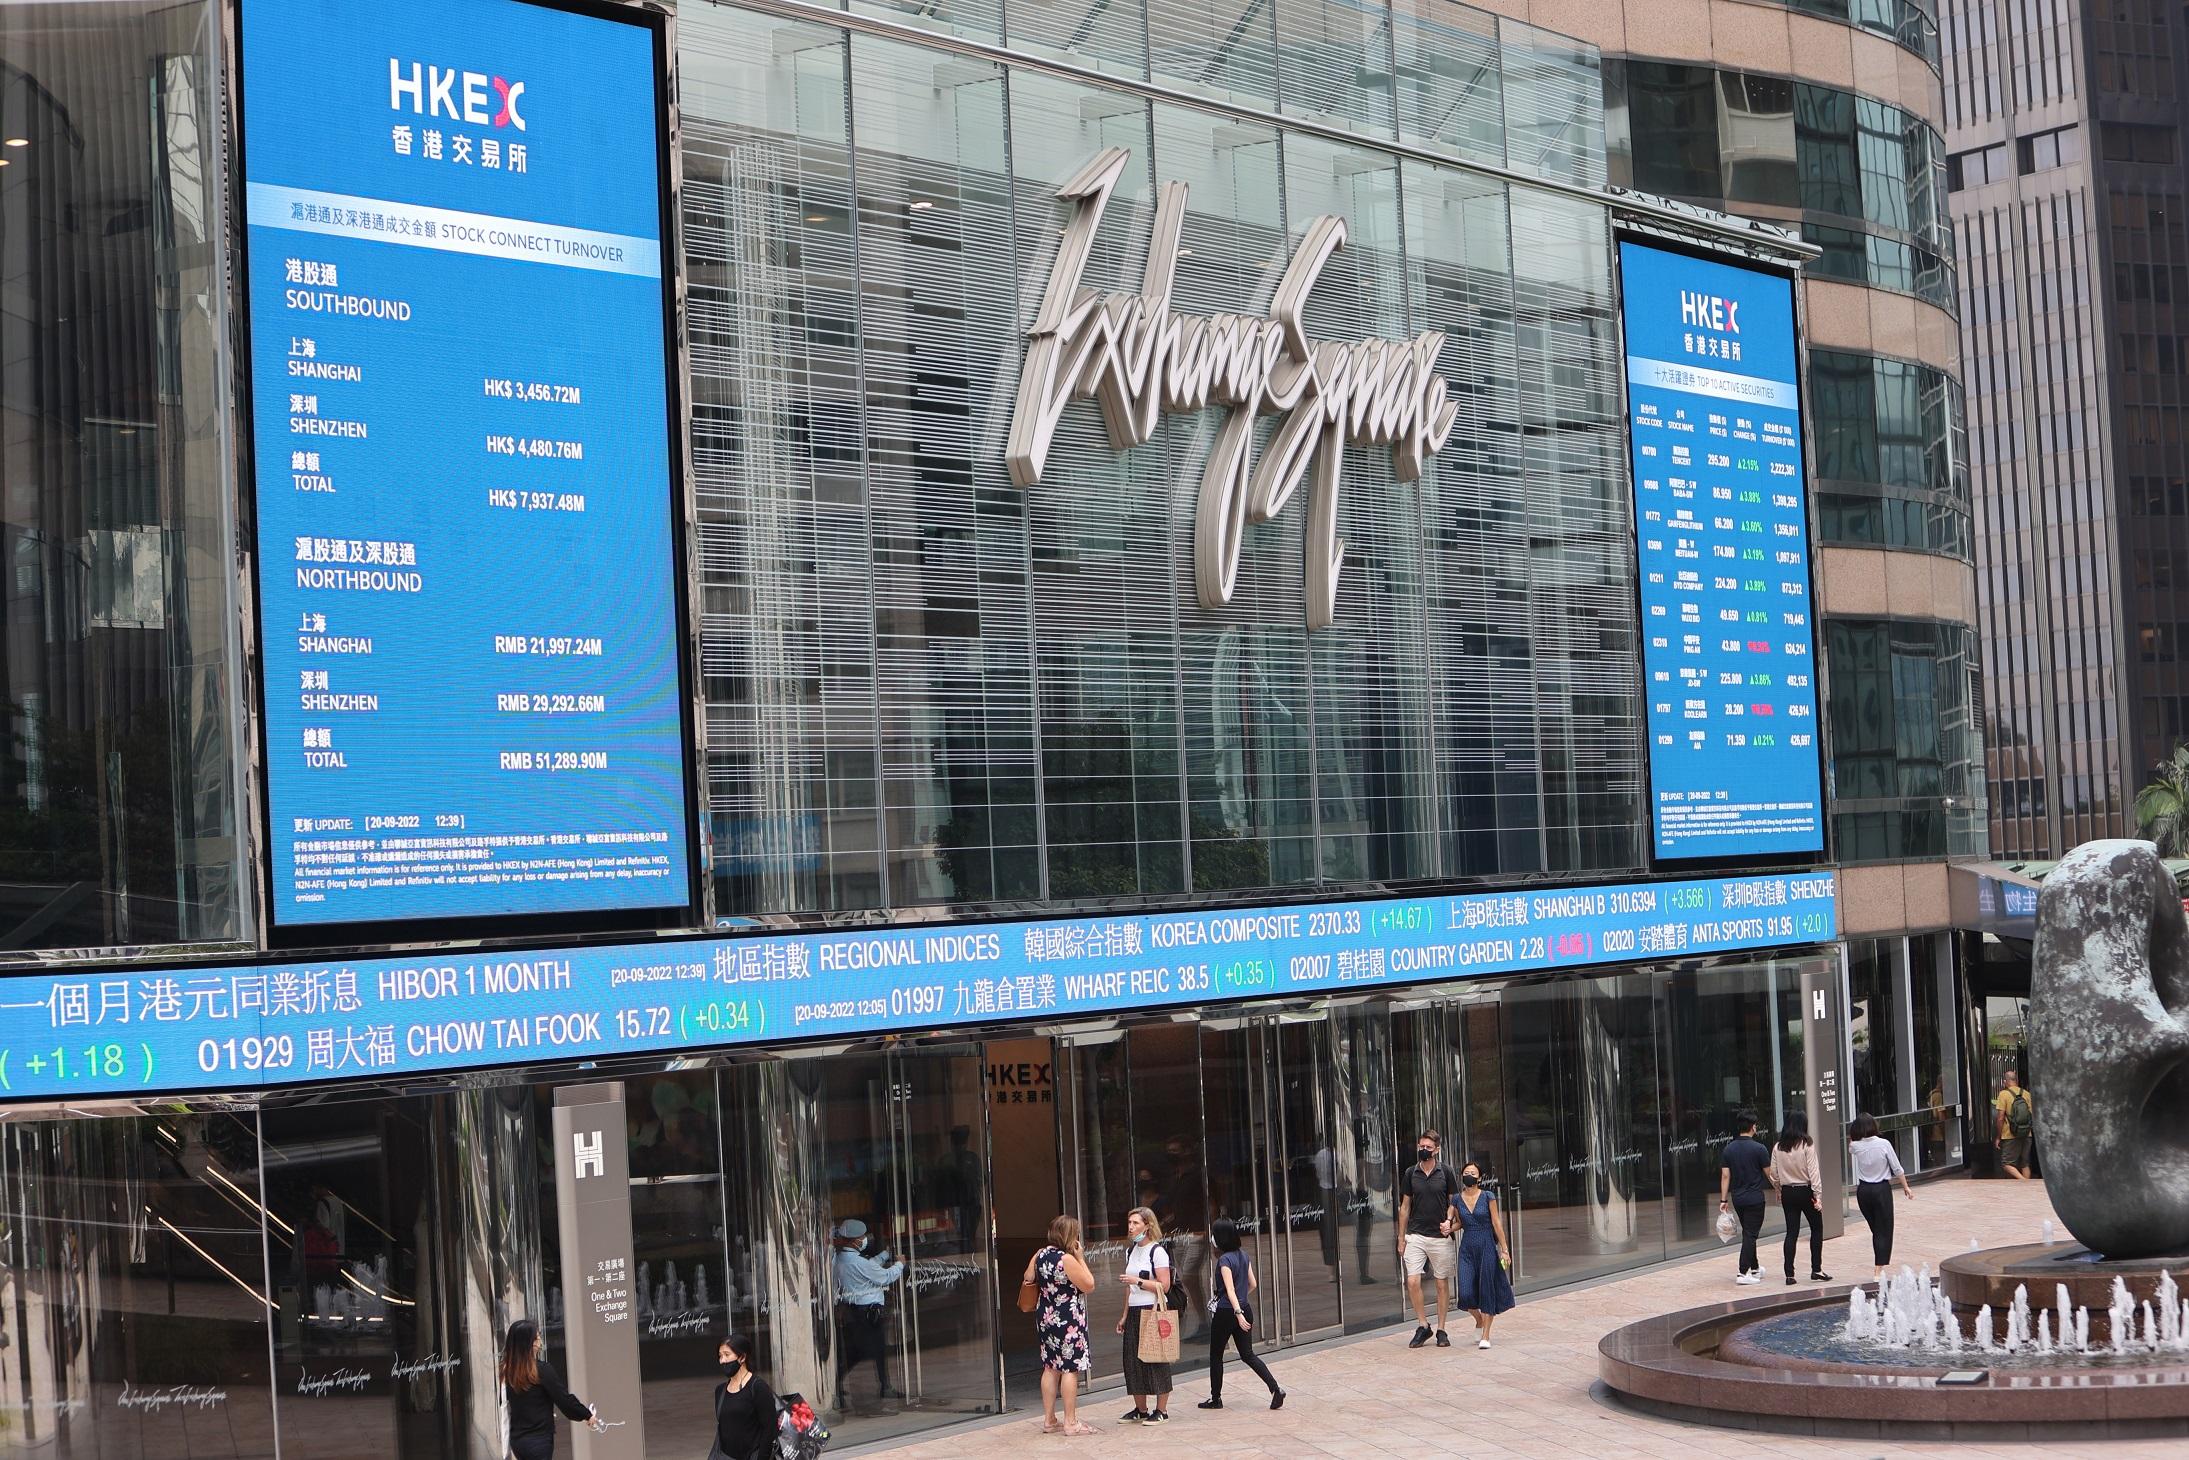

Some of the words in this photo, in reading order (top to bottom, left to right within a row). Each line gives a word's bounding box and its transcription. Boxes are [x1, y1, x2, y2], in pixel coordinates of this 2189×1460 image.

[390, 57, 526, 131] HKEX
[392, 125, 527, 173] 香港交易所
[290, 202, 436, 239] 滬港通及深港通成交金額
[442, 224, 485, 244] STOCK
[489, 231, 551, 252] CONNECT
[555, 239, 623, 262] TURNOVER
[285, 258, 337, 287] 港股通
[286, 290, 410, 321] SOUTHBOUND
[1681, 290, 1740, 334] HKEX
[288, 337, 316, 358] 上海
[1684, 333, 1741, 361] 香港交易所
[288, 360, 361, 382] SHANGHAI
[484, 378, 512, 399] HK$
[516, 381, 580, 404] 3,456.72M
[1698, 376, 1710, 387] TOP
[1711, 378, 1718, 389] 10
[1719, 380, 1740, 393] ACTIVE
[1741, 383, 1774, 399] SECURITIES
[289, 394, 317, 415] 深圳
[290, 418, 367, 438] SHENZHEN
[487, 435, 515, 456] HK$
[518, 438, 582, 460] 4,480.76M
[291, 451, 320, 472] 總額
[292, 475, 336, 493] TOTAL
[489, 489, 517, 510] HK$
[520, 491, 585, 512] 7,937.48M
[295, 536, 416, 566] 滬股通及深股通
[296, 568, 422, 592] NORTHBOUND
[298, 612, 326, 633] 上海
[299, 636, 372, 654] SHANGHAI
[495, 636, 527, 655] RMB
[530, 636, 602, 657] 21,997.24M
[300, 670, 328, 691] 深圳
[301, 694, 378, 711] SHENZHEN
[497, 694, 530, 712] RMB
[532, 694, 605, 715] 29,292.66M
[303, 728, 331, 749] 總額
[304, 751, 347, 768] TOTAL
[500, 752, 533, 770] RMB
[535, 752, 607, 771] 51,289.90M
[314, 818, 353, 831] UPDATE:
[1, 968, 362, 1028] 一個月港元同業拆息
[379, 967, 457, 1000] HIBOR
[466, 966, 476, 994] 1
[485, 960, 570, 993] MONTH
[611, 965, 672, 988] [20-09-2022
[675, 963, 706, 982] 12:39]
[713, 941, 811, 985] 地區指數
[820, 938, 921, 971] REGIONAL
[926, 934, 1000, 963] INDICES
[1024, 921, 1143, 963] 韓國綜合指數
[1152, 920, 1207, 948] KOREA
[1211, 914, 1301, 945] COMPOSITE
[1309, 911, 1361, 937] 2370.33
[1446, 898, 1530, 931] 上海B股指數
[1534, 896, 1596, 919] SHANGHAI
[1598, 897, 1605, 915] B
[1610, 890, 1656, 914] 310.6394
[1722, 880, 1788, 908] 深圳B股指數
[1790, 878, 1835, 900] SHENZHE
[199, 1035, 293, 1073] 01929
[307, 1025, 395, 1073] 周大福
[407, 1021, 485, 1056] CHOW
[491, 1018, 528, 1048] TAI
[536, 1012, 601, 1045] FOOK
[616, 1006, 671, 1038] 15.72
[795, 1002, 854, 1026] [20-09-2022
[857, 999, 887, 1018] 12:05]
[892, 986, 944, 1017] 01997
[952, 973, 1056, 1017] 九龍倉置業
[1065, 970, 1126, 1001] WHARF
[1131, 968, 1169, 995] REIC
[1178, 965, 1209, 991] 38.5
[1290, 955, 1331, 981] 02007
[1337, 948, 1386, 982] 碧桂園
[1391, 944, 1455, 972] COUNTRY
[1459, 940, 1513, 967] GARDEN
[1520, 938, 1544, 960] 2.28
[1603, 931, 1634, 953] 02020
[1639, 924, 1688, 955] 安踏體育
[1692, 922, 1721, 944] ANTA
[1722, 918, 1764, 941] SPORTS
[1768, 916, 1793, 937] 91.95
[591, 1292, 605, 1302] One
[606, 1289, 612, 1300] &
[612, 1288, 627, 1298] Two
[595, 1301, 627, 1313] Exchange
[604, 1312, 628, 1323] Square
